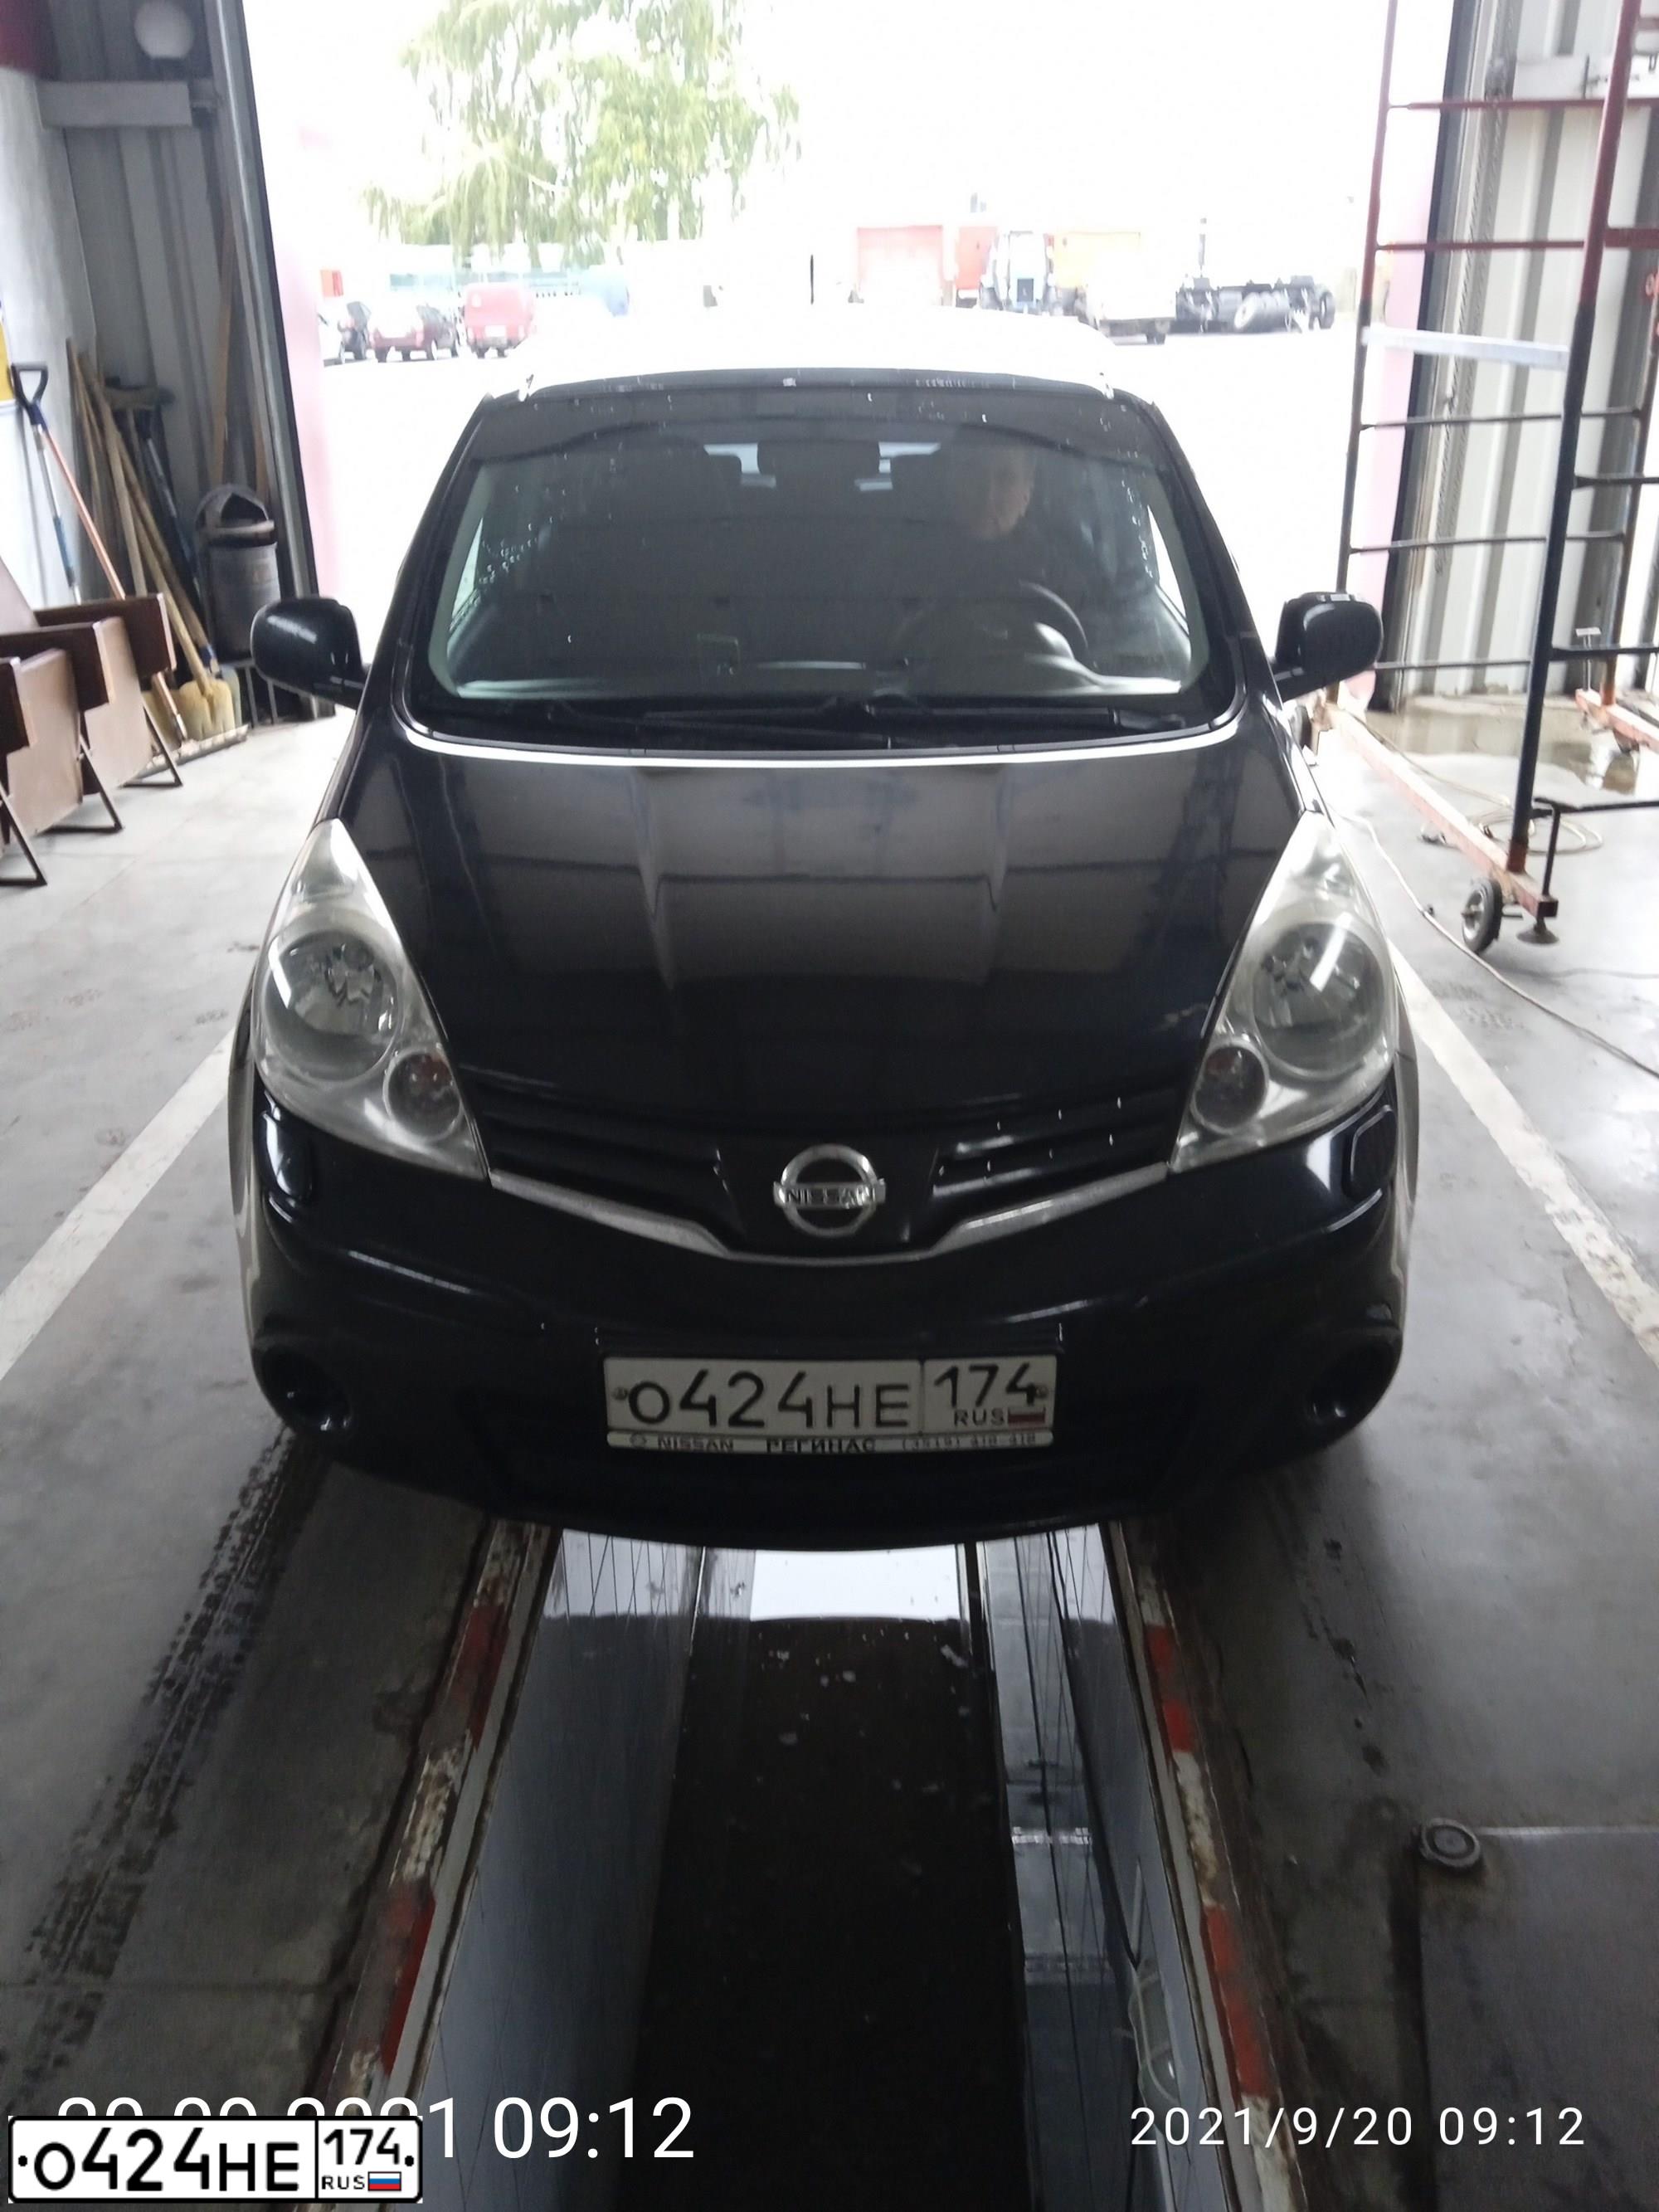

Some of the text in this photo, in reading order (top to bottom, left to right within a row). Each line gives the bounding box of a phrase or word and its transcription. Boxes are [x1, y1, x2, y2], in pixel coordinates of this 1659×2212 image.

[933, 1362, 1038, 1408] 174
[953, 1408, 1005, 1426] RUS
[657, 1435, 734, 1451] NISSAN
